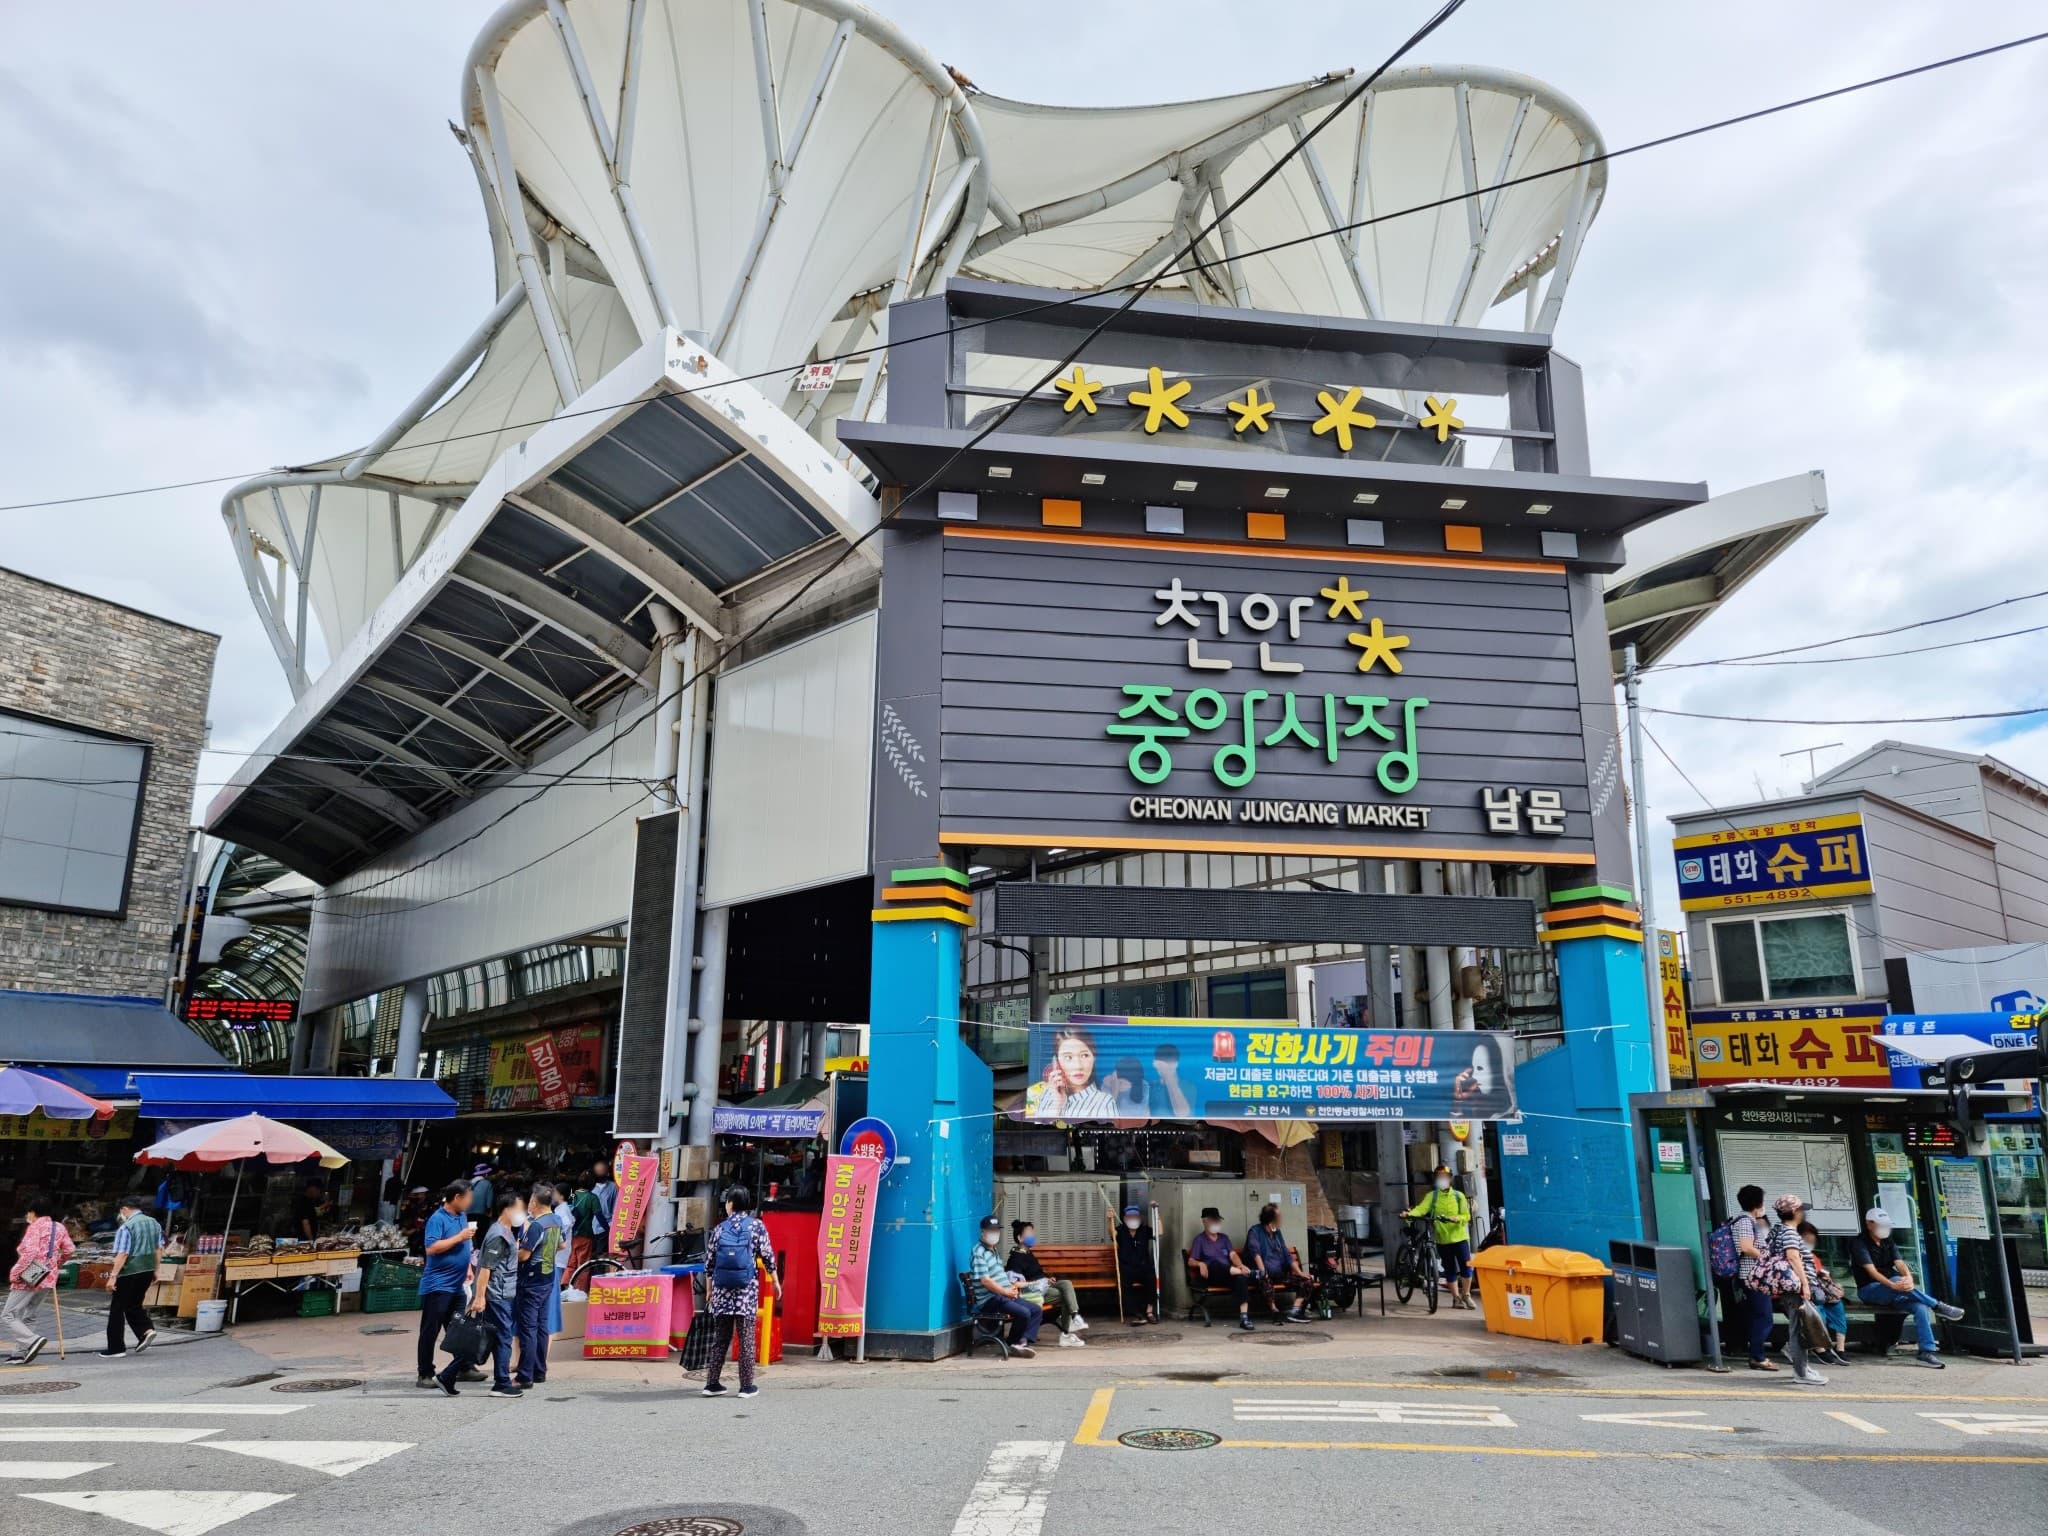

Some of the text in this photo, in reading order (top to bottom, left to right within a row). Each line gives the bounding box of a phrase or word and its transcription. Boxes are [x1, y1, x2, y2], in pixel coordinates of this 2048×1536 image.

[1155, 577, 1314, 673] 천안
[1106, 685, 1429, 793] 중앙시장
[1129, 797, 1431, 828] CHEONAN JUNGANG MARKET
[1482, 787, 1566, 834] 남문
[1723, 887, 1811, 905] 551-4892
[1246, 1032, 1434, 1067] 전화사기 주의!
[1994, 1038, 2025, 1048] ONE
[1204, 1067, 1438, 1084] 저금리 대출로 바꿔준다며 기존 대출금을 상환할
[1229, 1084, 1415, 1100] 현금을 요구하면 100% 사기입니다.
[1259, 1106, 1291, 1116] 천안시
[1741, 1110, 1793, 1123] 천안중앙시장
[822, 1164, 855, 1309] 중앙보청기
[589, 1285, 660, 1304] 중앙보청기
